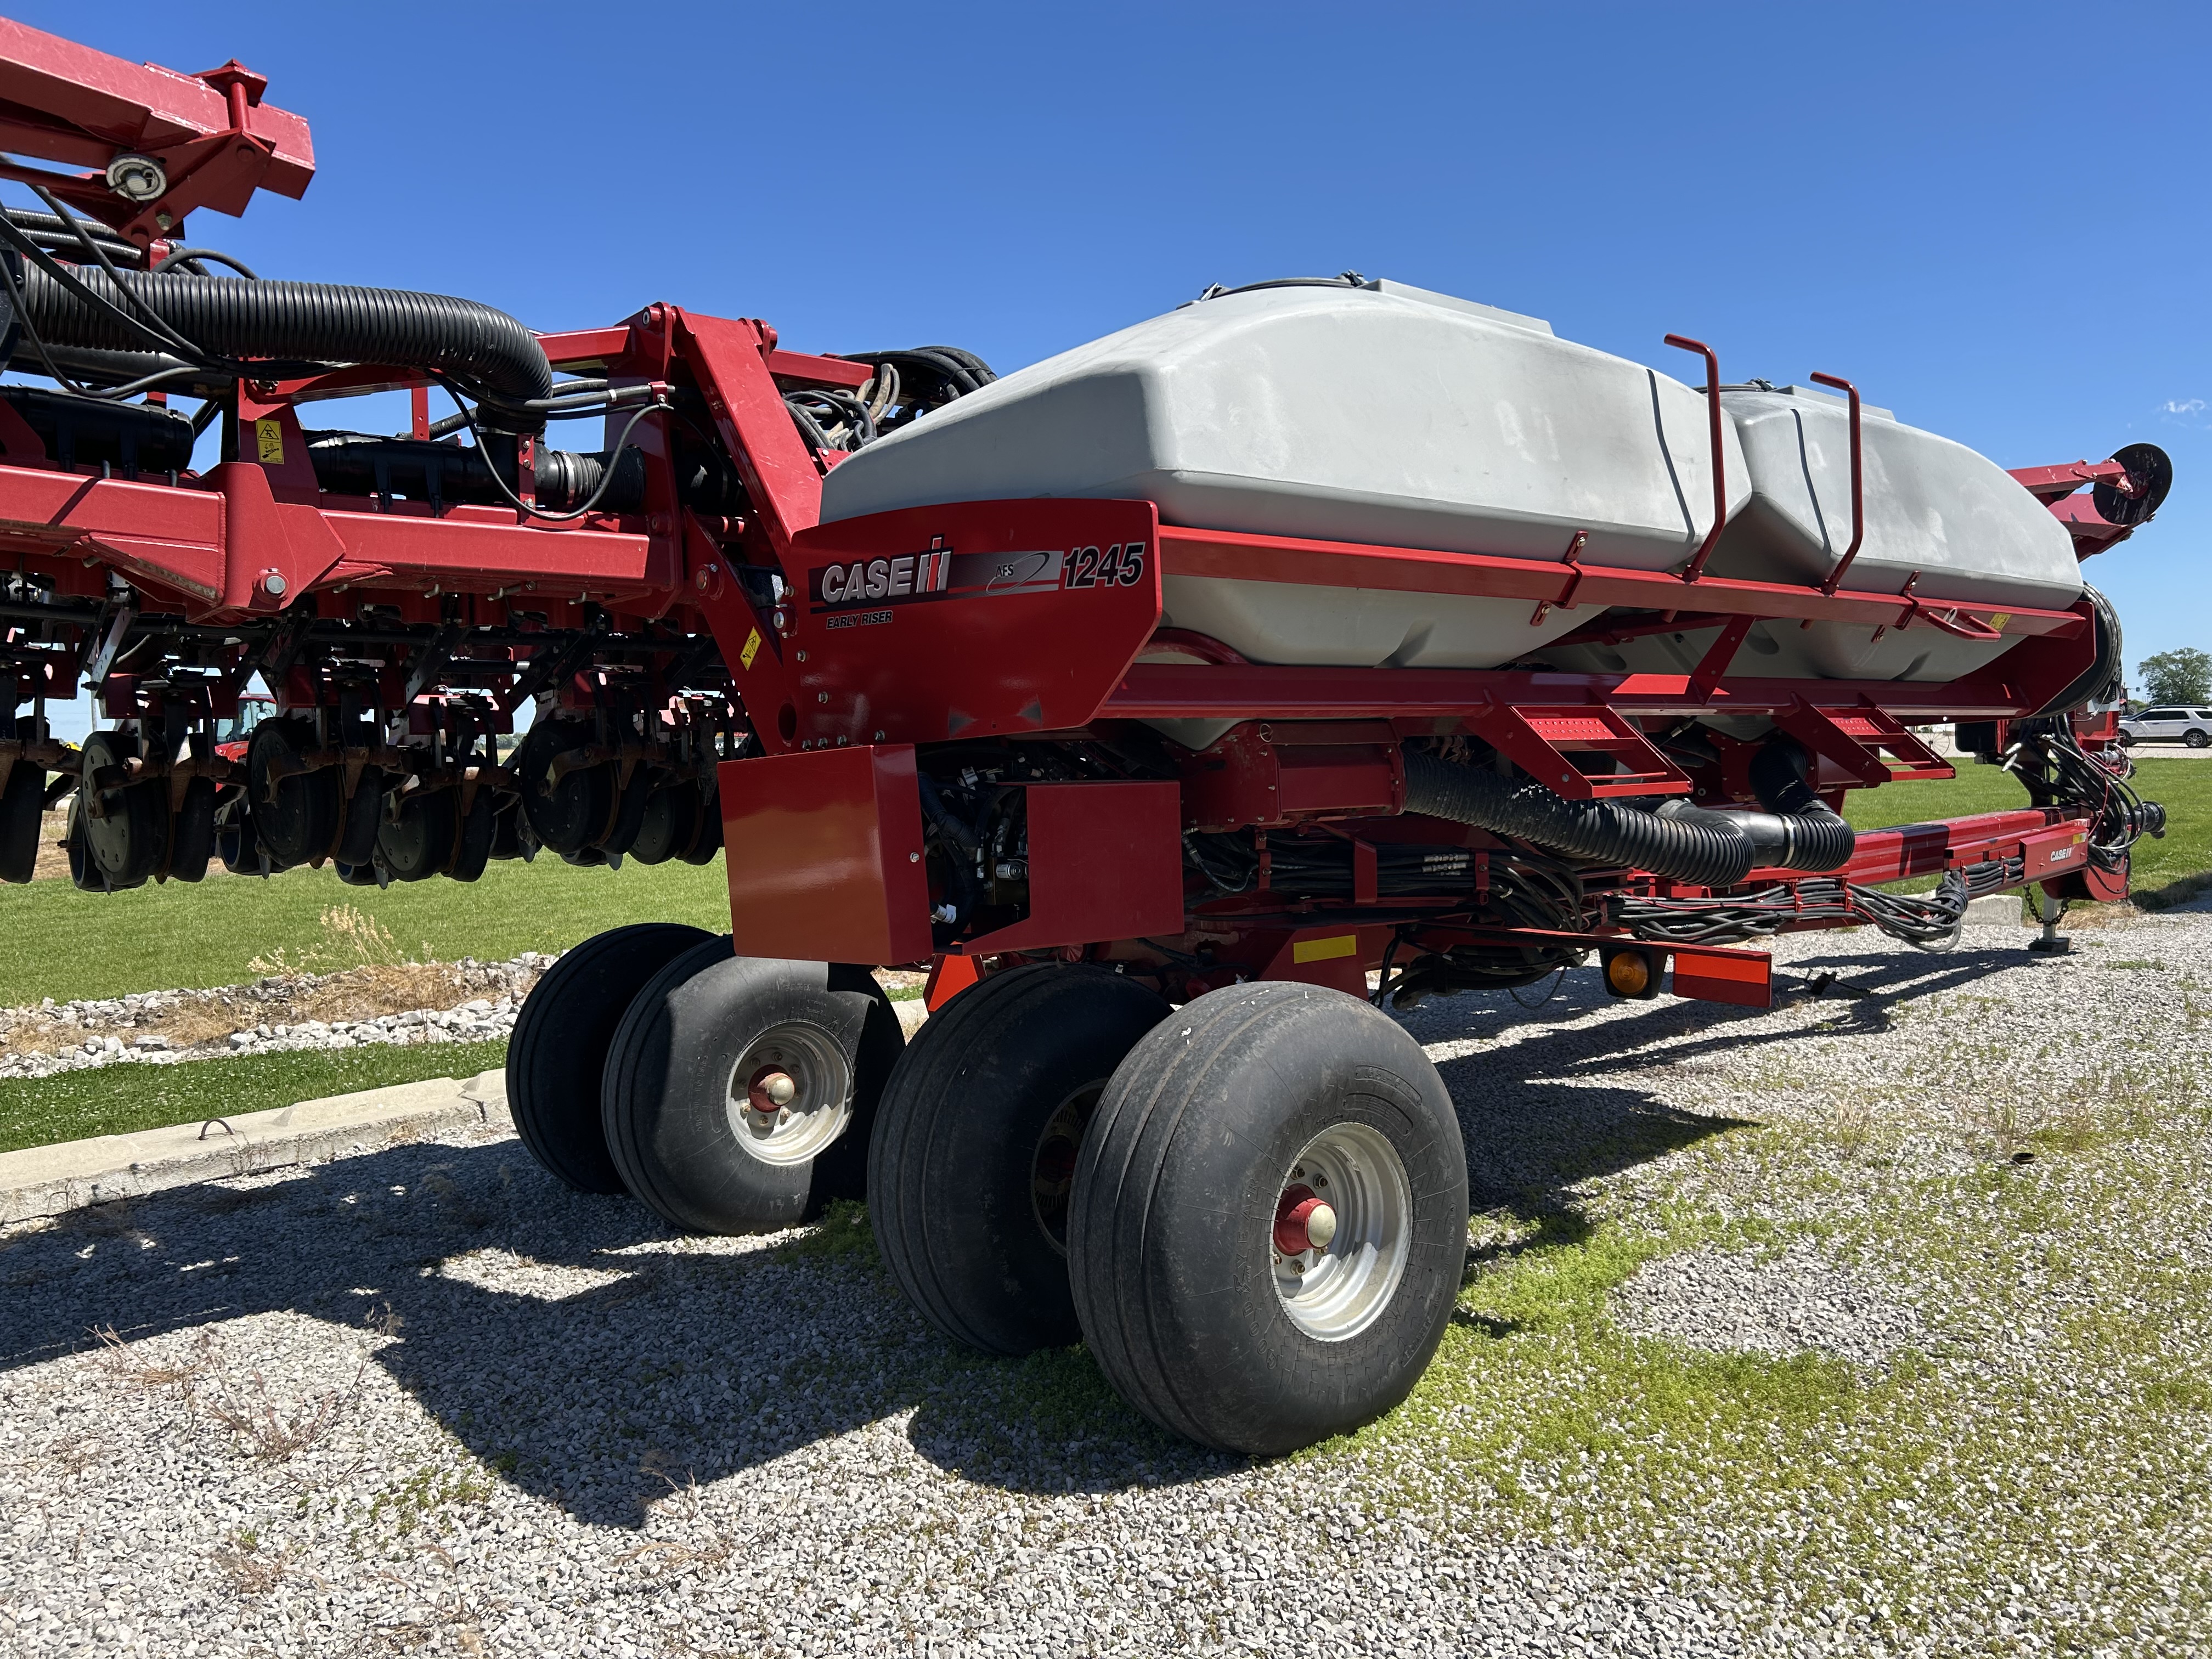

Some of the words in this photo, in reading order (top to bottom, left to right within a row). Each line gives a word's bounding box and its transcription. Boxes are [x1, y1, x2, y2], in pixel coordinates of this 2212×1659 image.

[995, 563, 1014, 578] AFS
[1063, 541, 1146, 590] 1245
[822, 556, 915, 603] CASE
[826, 614, 861, 630] EARLY
[860, 610, 894, 626] RISER
[2050, 848, 2067, 862] CASE
